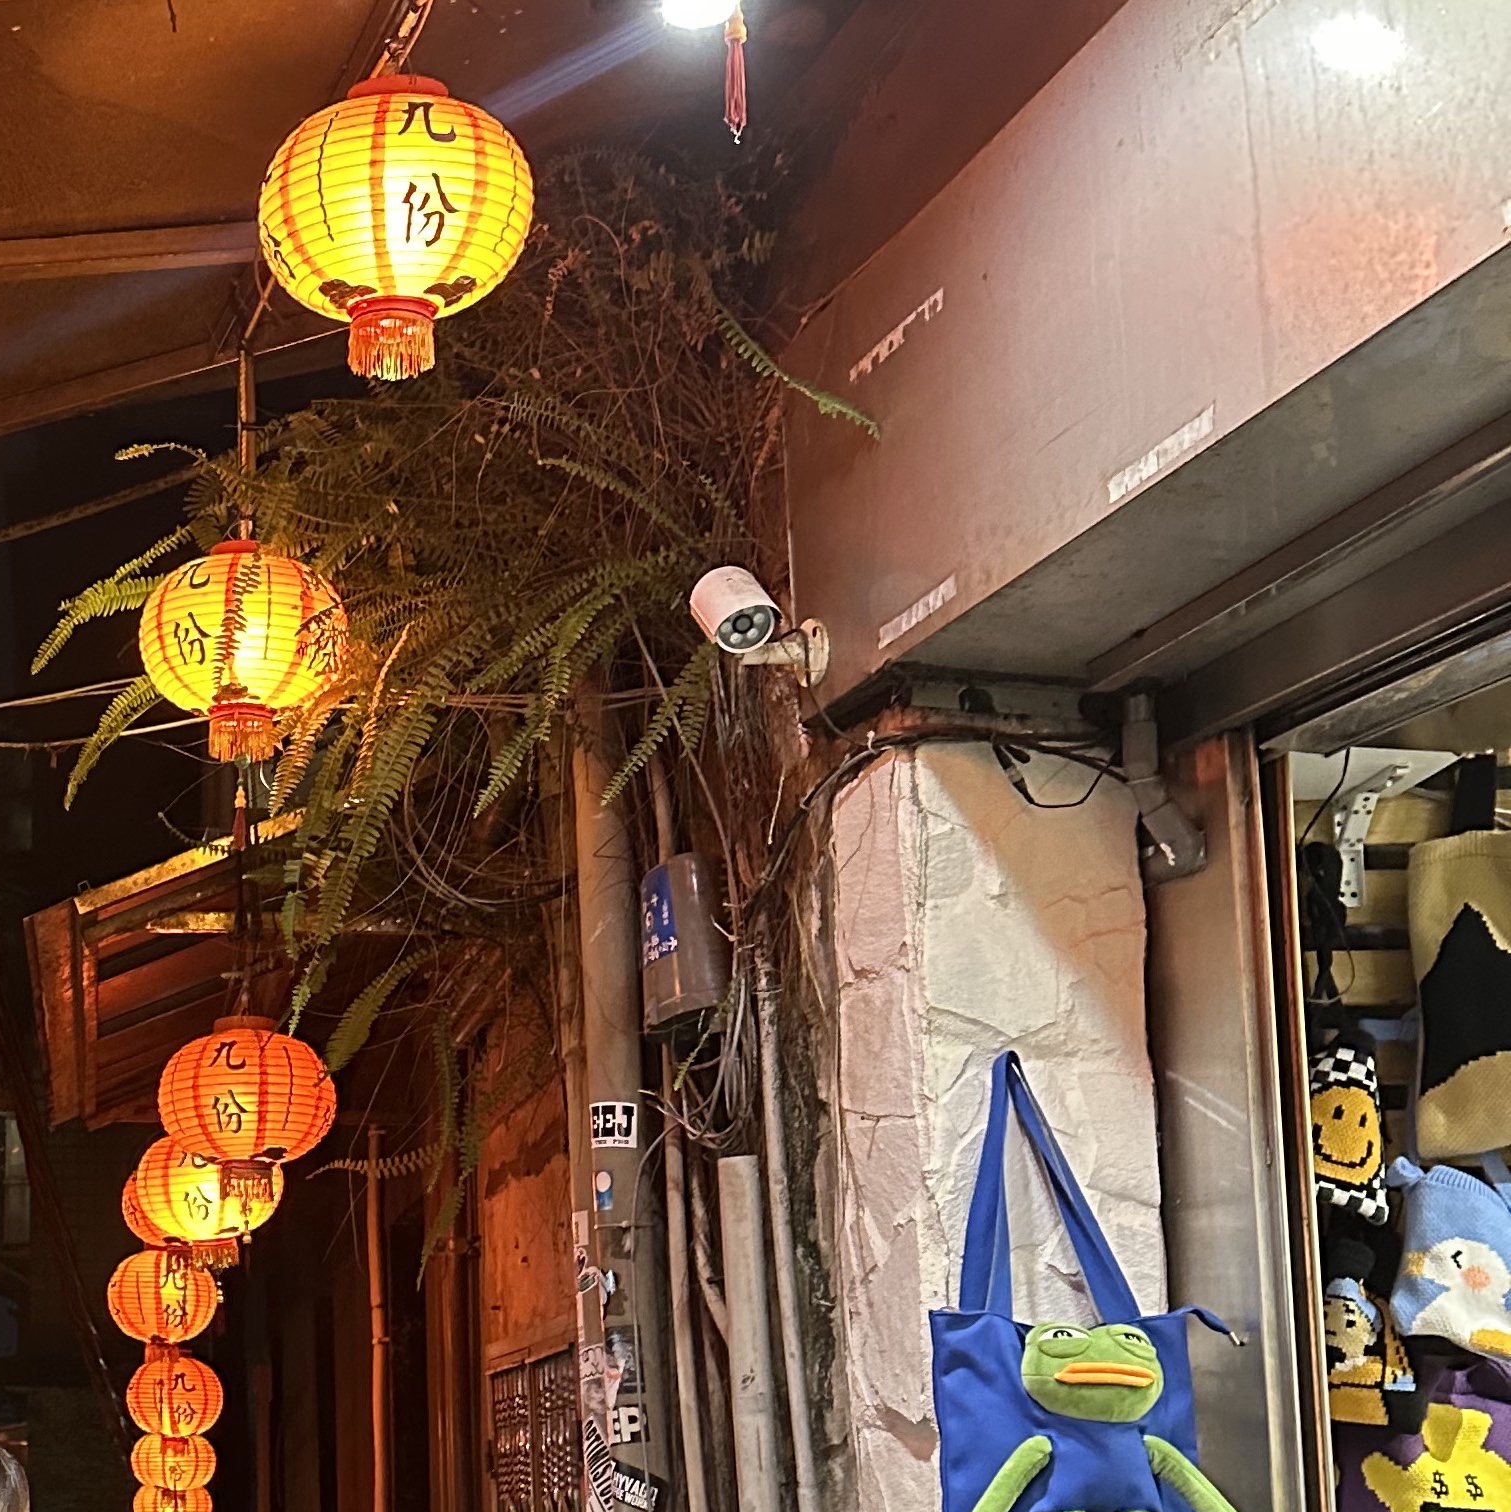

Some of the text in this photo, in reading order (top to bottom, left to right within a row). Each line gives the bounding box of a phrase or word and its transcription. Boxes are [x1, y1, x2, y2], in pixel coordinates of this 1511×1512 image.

[397, 101, 459, 248] 九份
[172, 560, 212, 666] 九份
[210, 1040, 248, 1134] 九份
